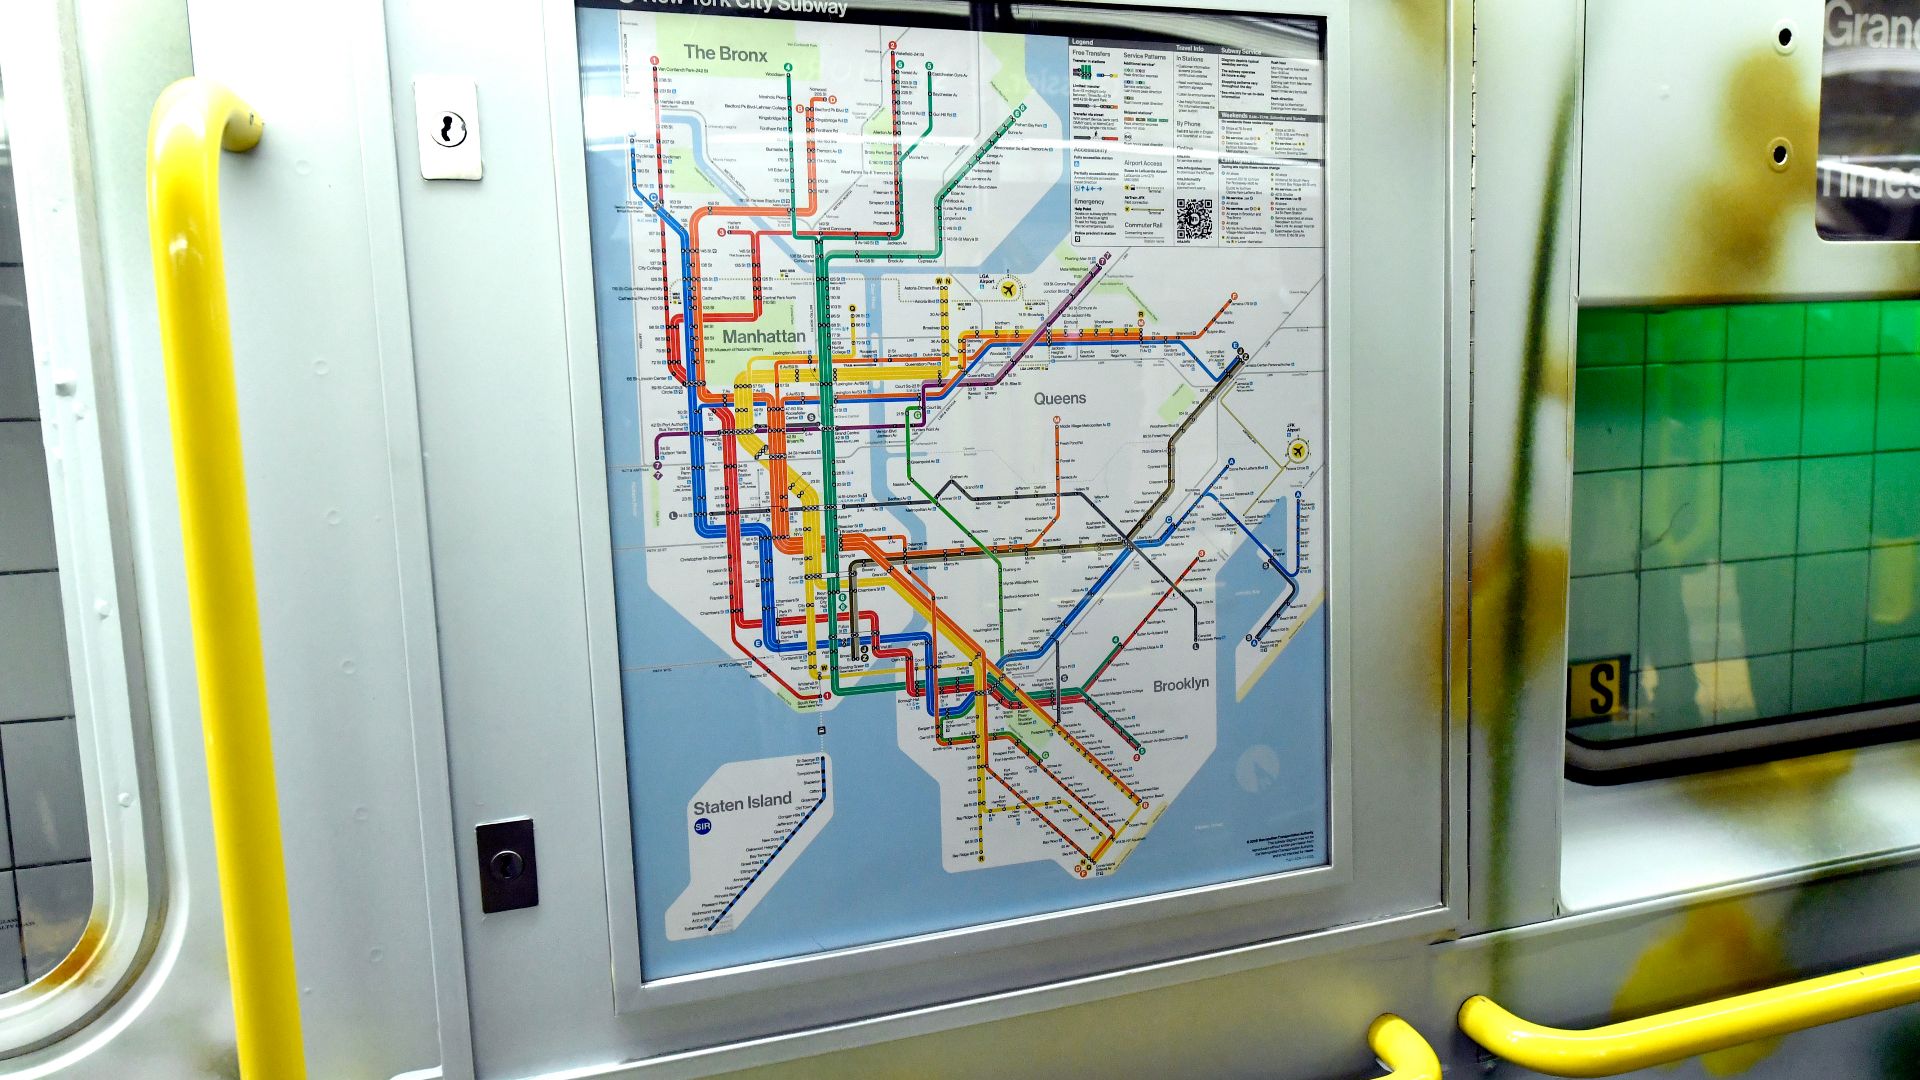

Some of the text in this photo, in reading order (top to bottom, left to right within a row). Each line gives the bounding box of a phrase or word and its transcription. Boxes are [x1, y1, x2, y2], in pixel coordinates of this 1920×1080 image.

[736, 0, 773, 13] City
[777, 0, 848, 18] Subway
[1825, 0, 1920, 49] Gran
[684, 44, 768, 63] The Bronx
[722, 329, 806, 344] Manhattan
[1034, 391, 1087, 406] Queens
[1153, 677, 1210, 692] Brooklyn
[693, 791, 792, 816] Staten Island
[695, 822, 711, 831] SIR
